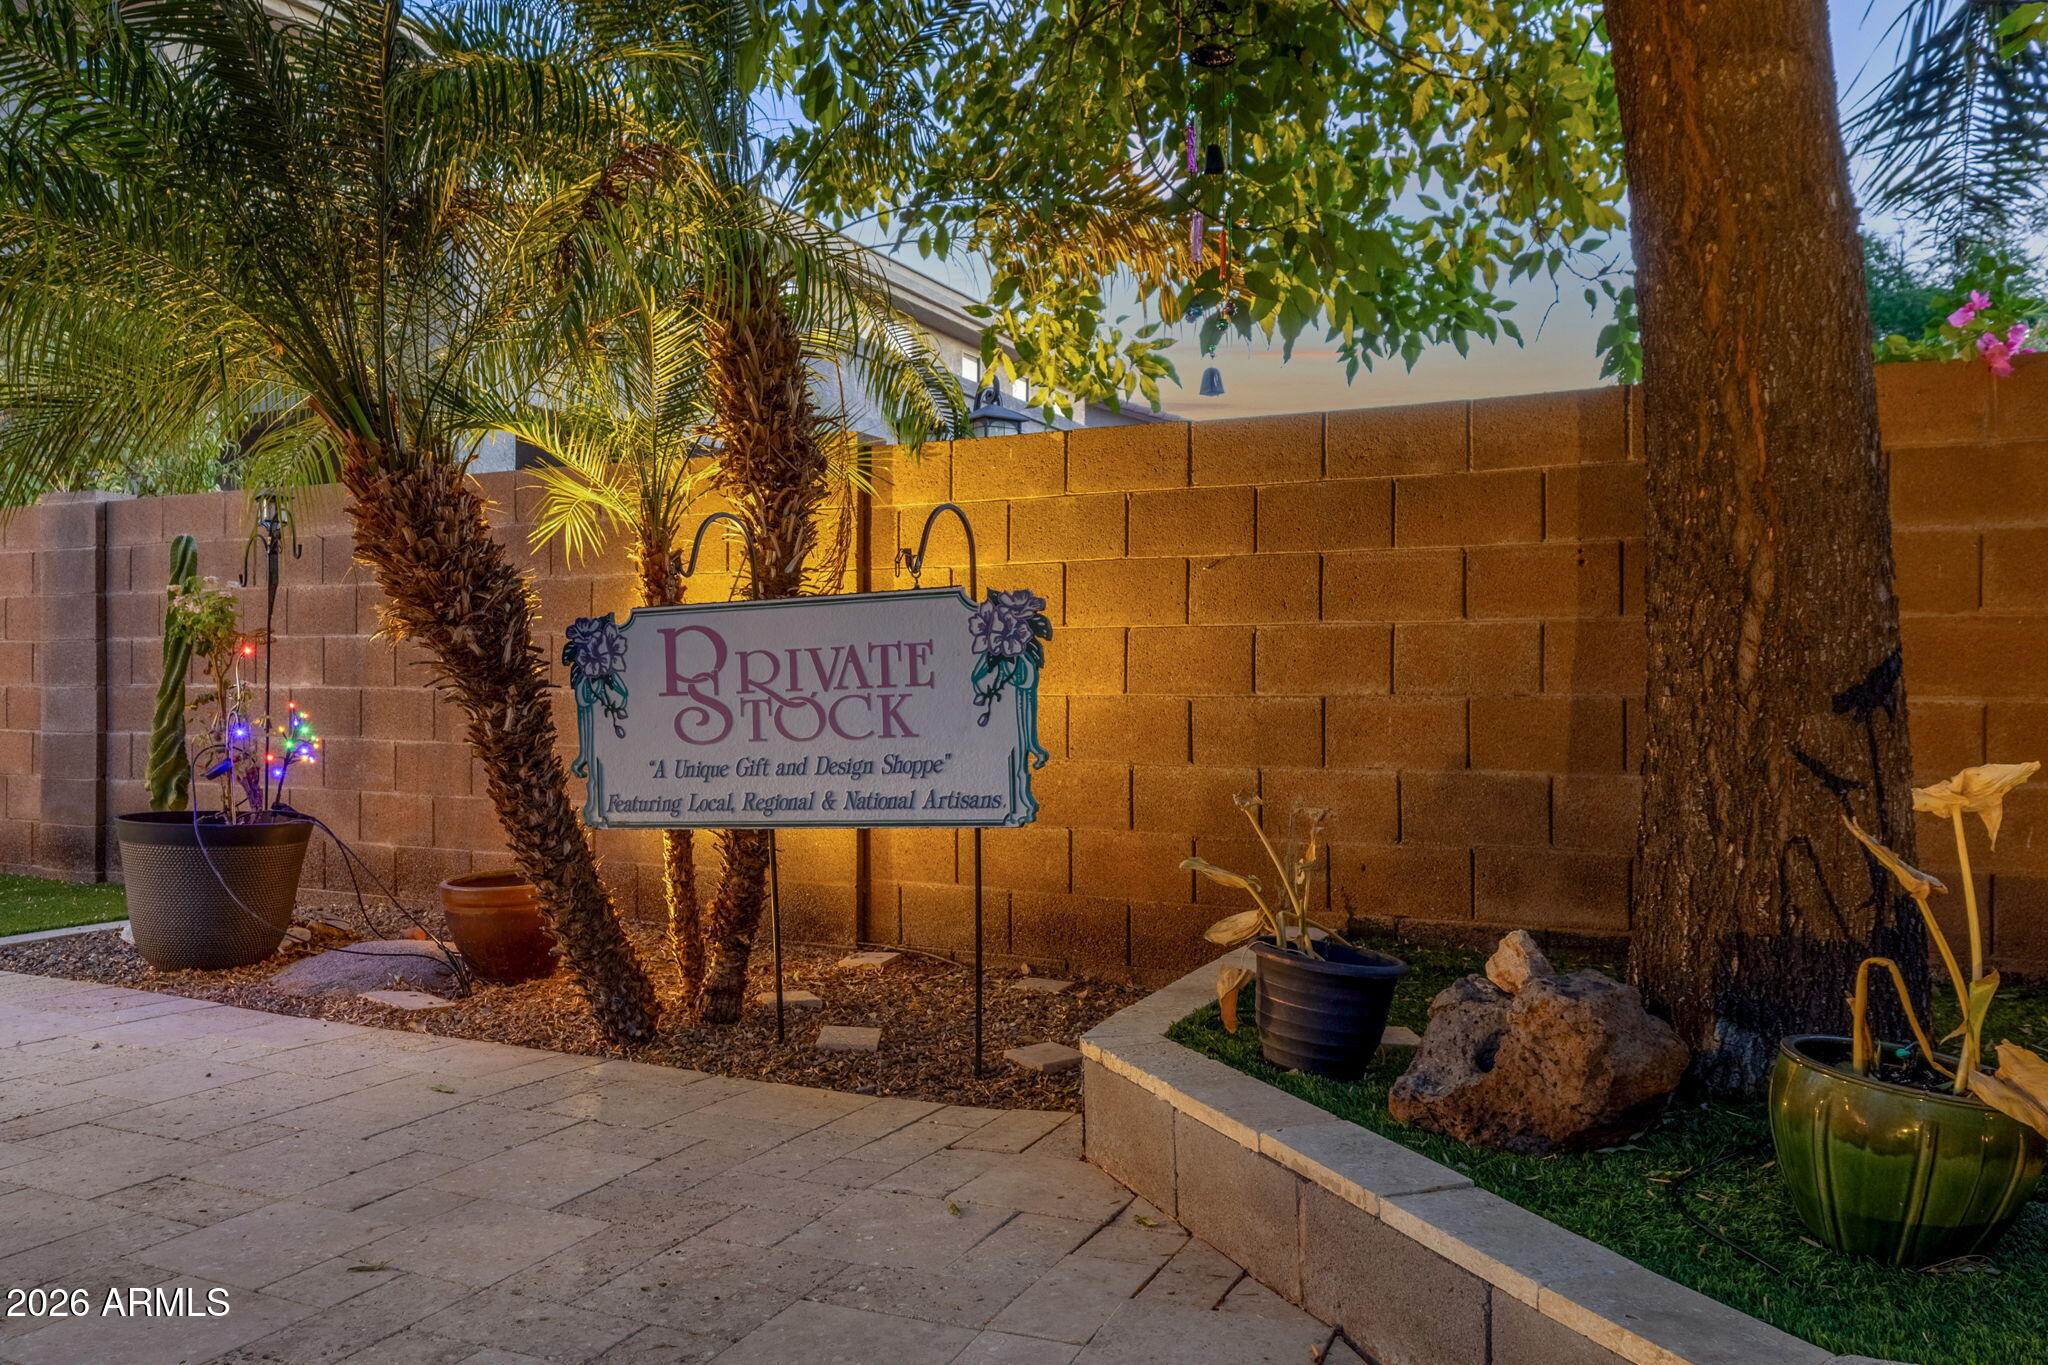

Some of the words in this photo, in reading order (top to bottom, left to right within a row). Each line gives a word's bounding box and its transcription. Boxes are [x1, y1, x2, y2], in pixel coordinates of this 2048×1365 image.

[656, 625, 935, 707] PRIVATE
[674, 671, 919, 746] STOCK
[674, 758, 729, 783] Unique
[735, 755, 769, 777] Gift
[775, 756, 808, 776] and
[814, 755, 873, 780] Design
[881, 752, 952, 778] Shoppe"
[606, 793, 682, 818] Featuring
[687, 792, 735, 814] Local,
[742, 790, 816, 816] Regional
[821, 791, 836, 810] &
[843, 790, 915, 812] National
